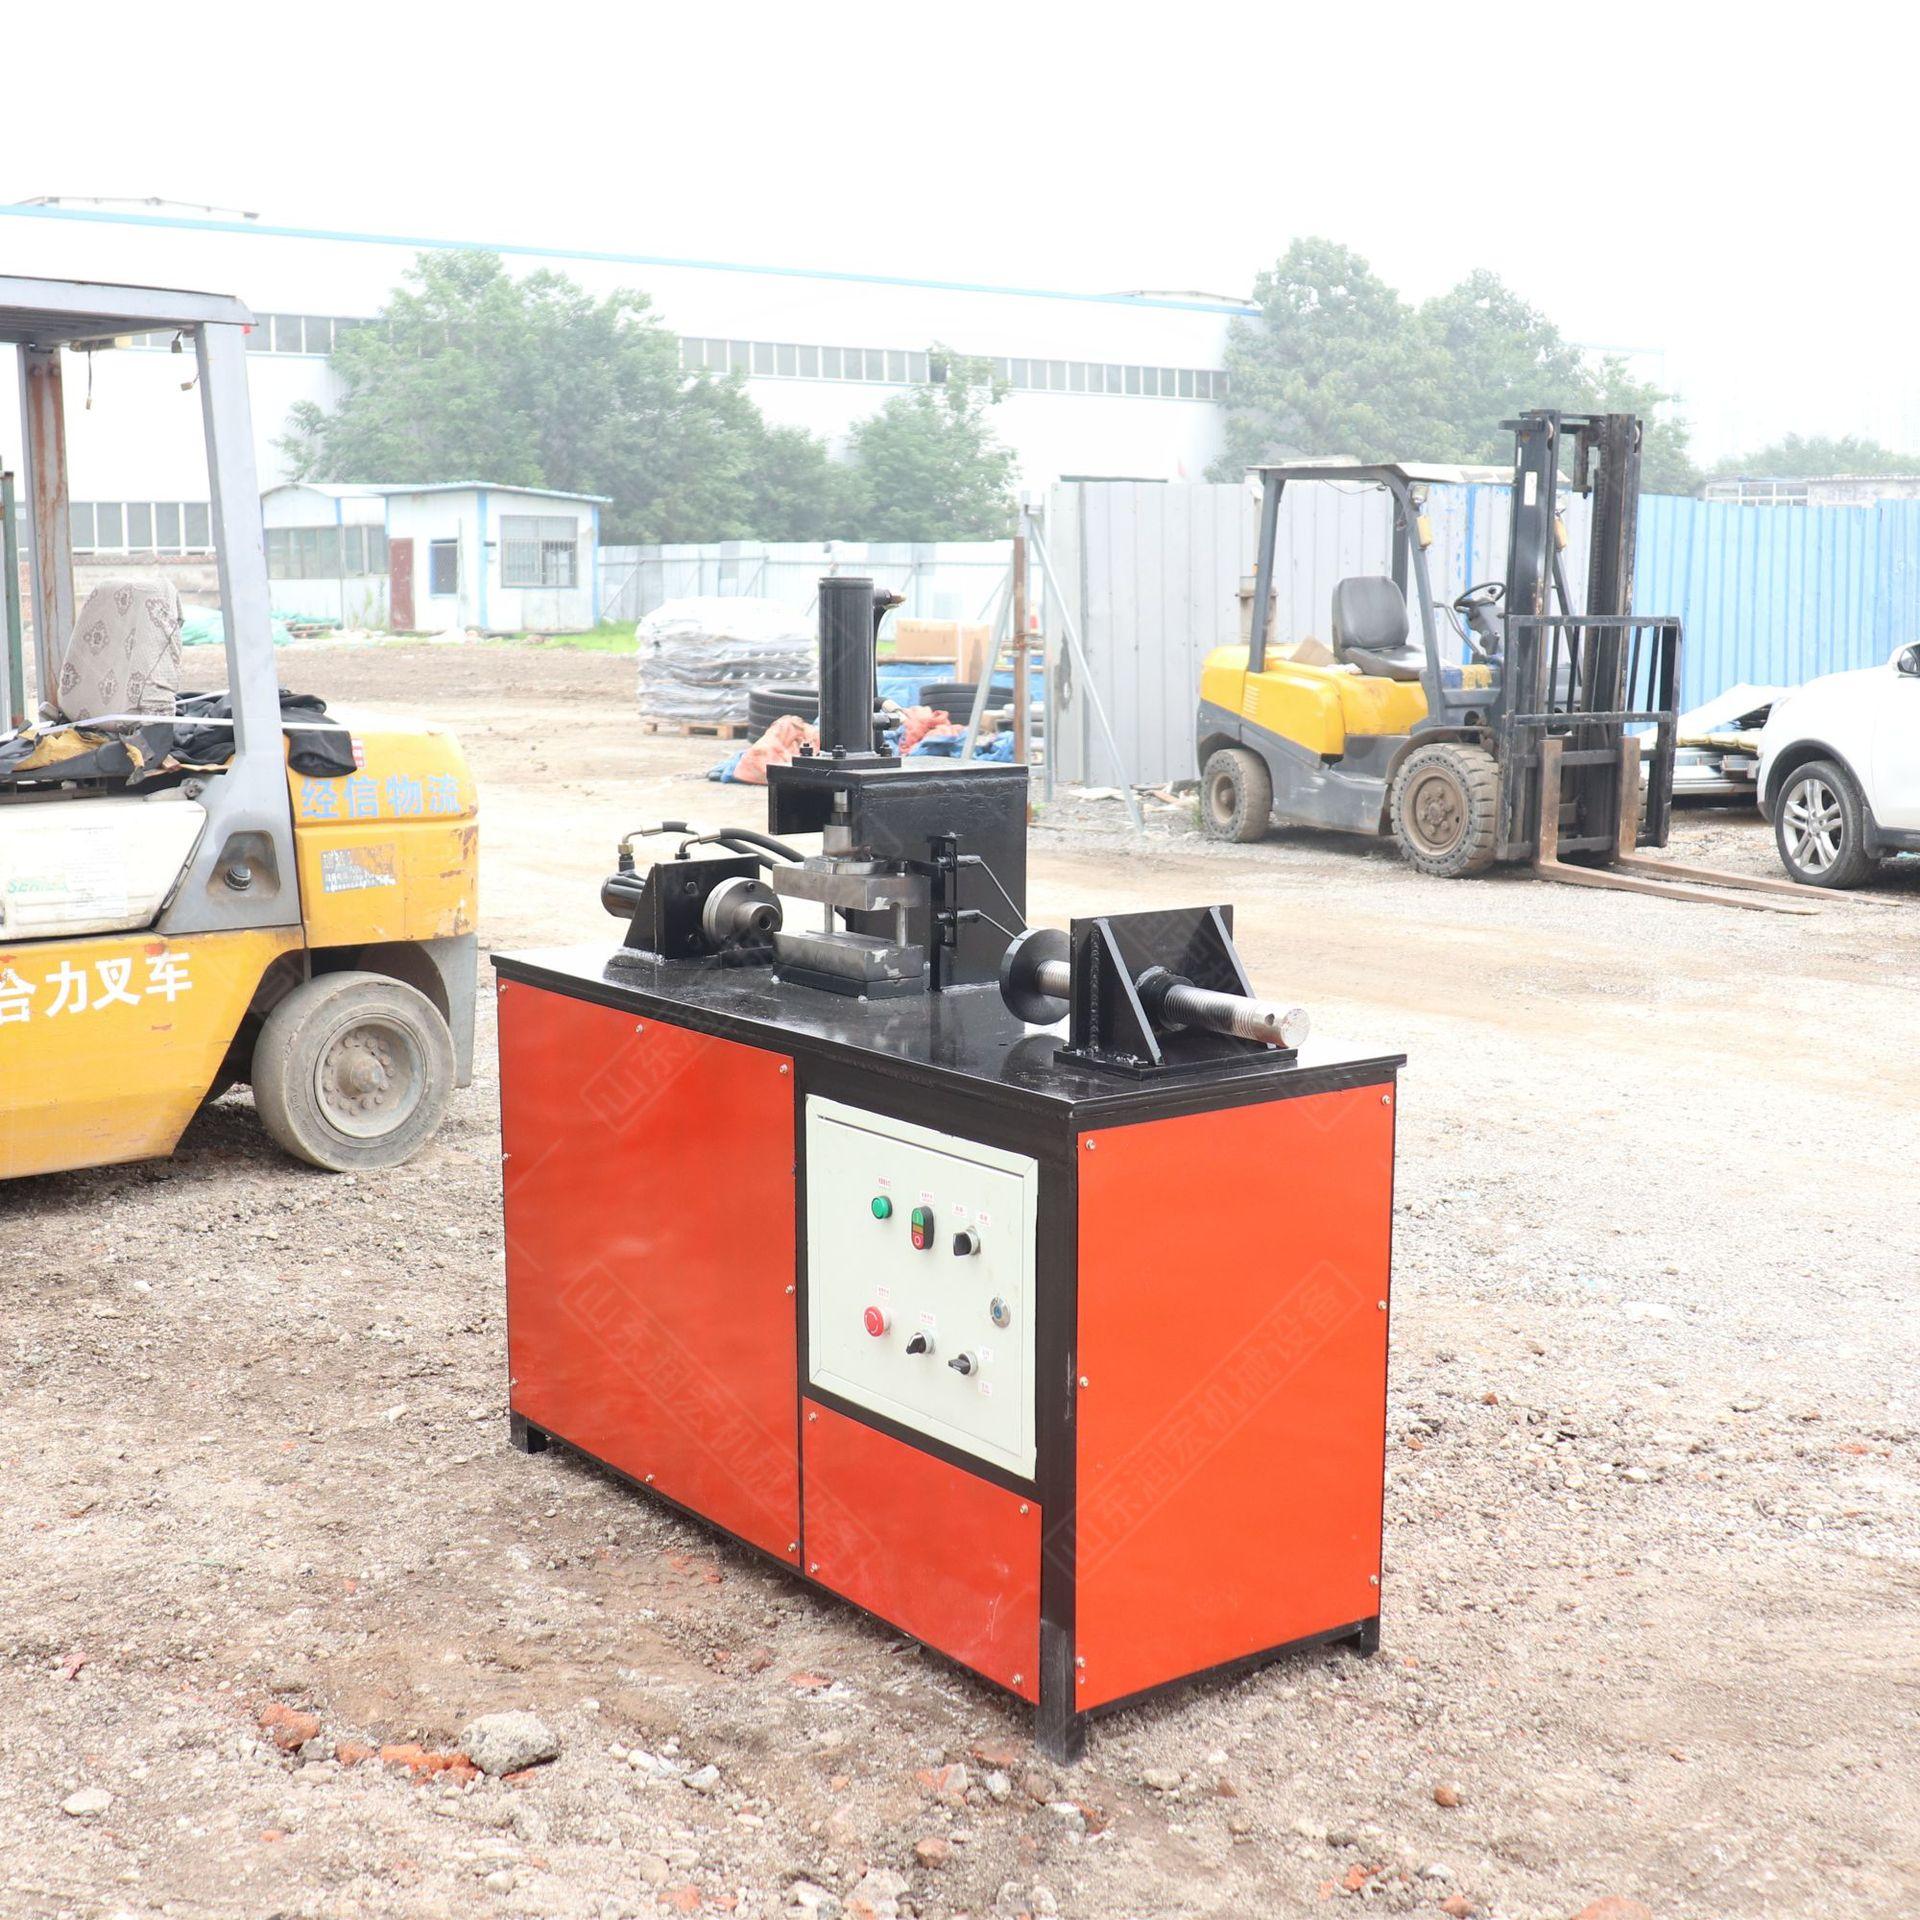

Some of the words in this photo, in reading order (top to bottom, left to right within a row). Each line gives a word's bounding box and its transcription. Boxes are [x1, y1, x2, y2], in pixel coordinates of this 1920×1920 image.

[300, 771, 462, 819] 经信物流
[0, 951, 193, 1027] 合力叉车
